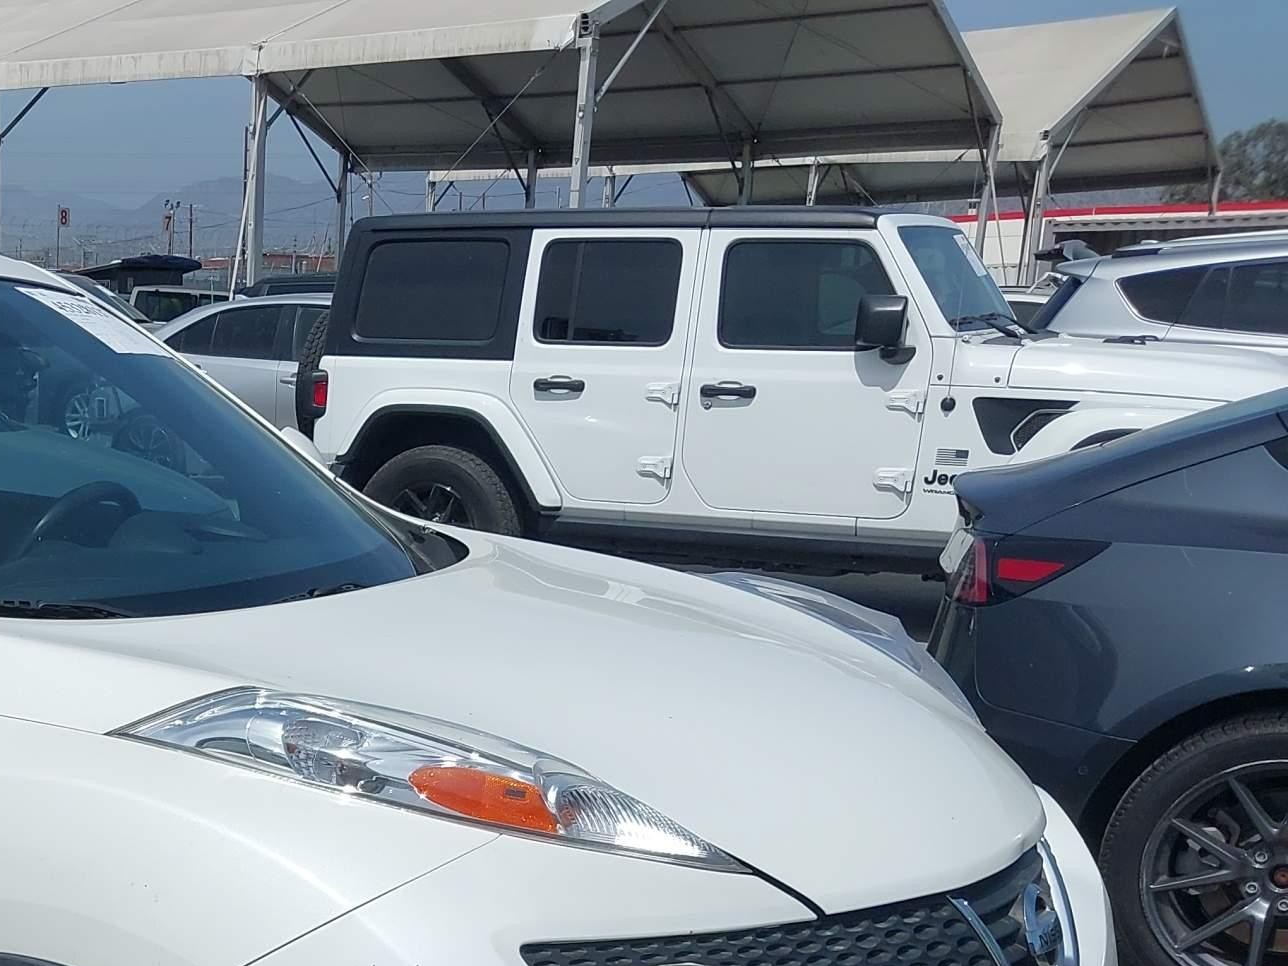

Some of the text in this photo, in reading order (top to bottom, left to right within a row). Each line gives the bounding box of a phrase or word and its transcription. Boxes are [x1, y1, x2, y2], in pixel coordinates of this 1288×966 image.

[60, 209, 68, 225] 8
[165, 216, 172, 231] 7
[924, 470, 957, 485] Je
